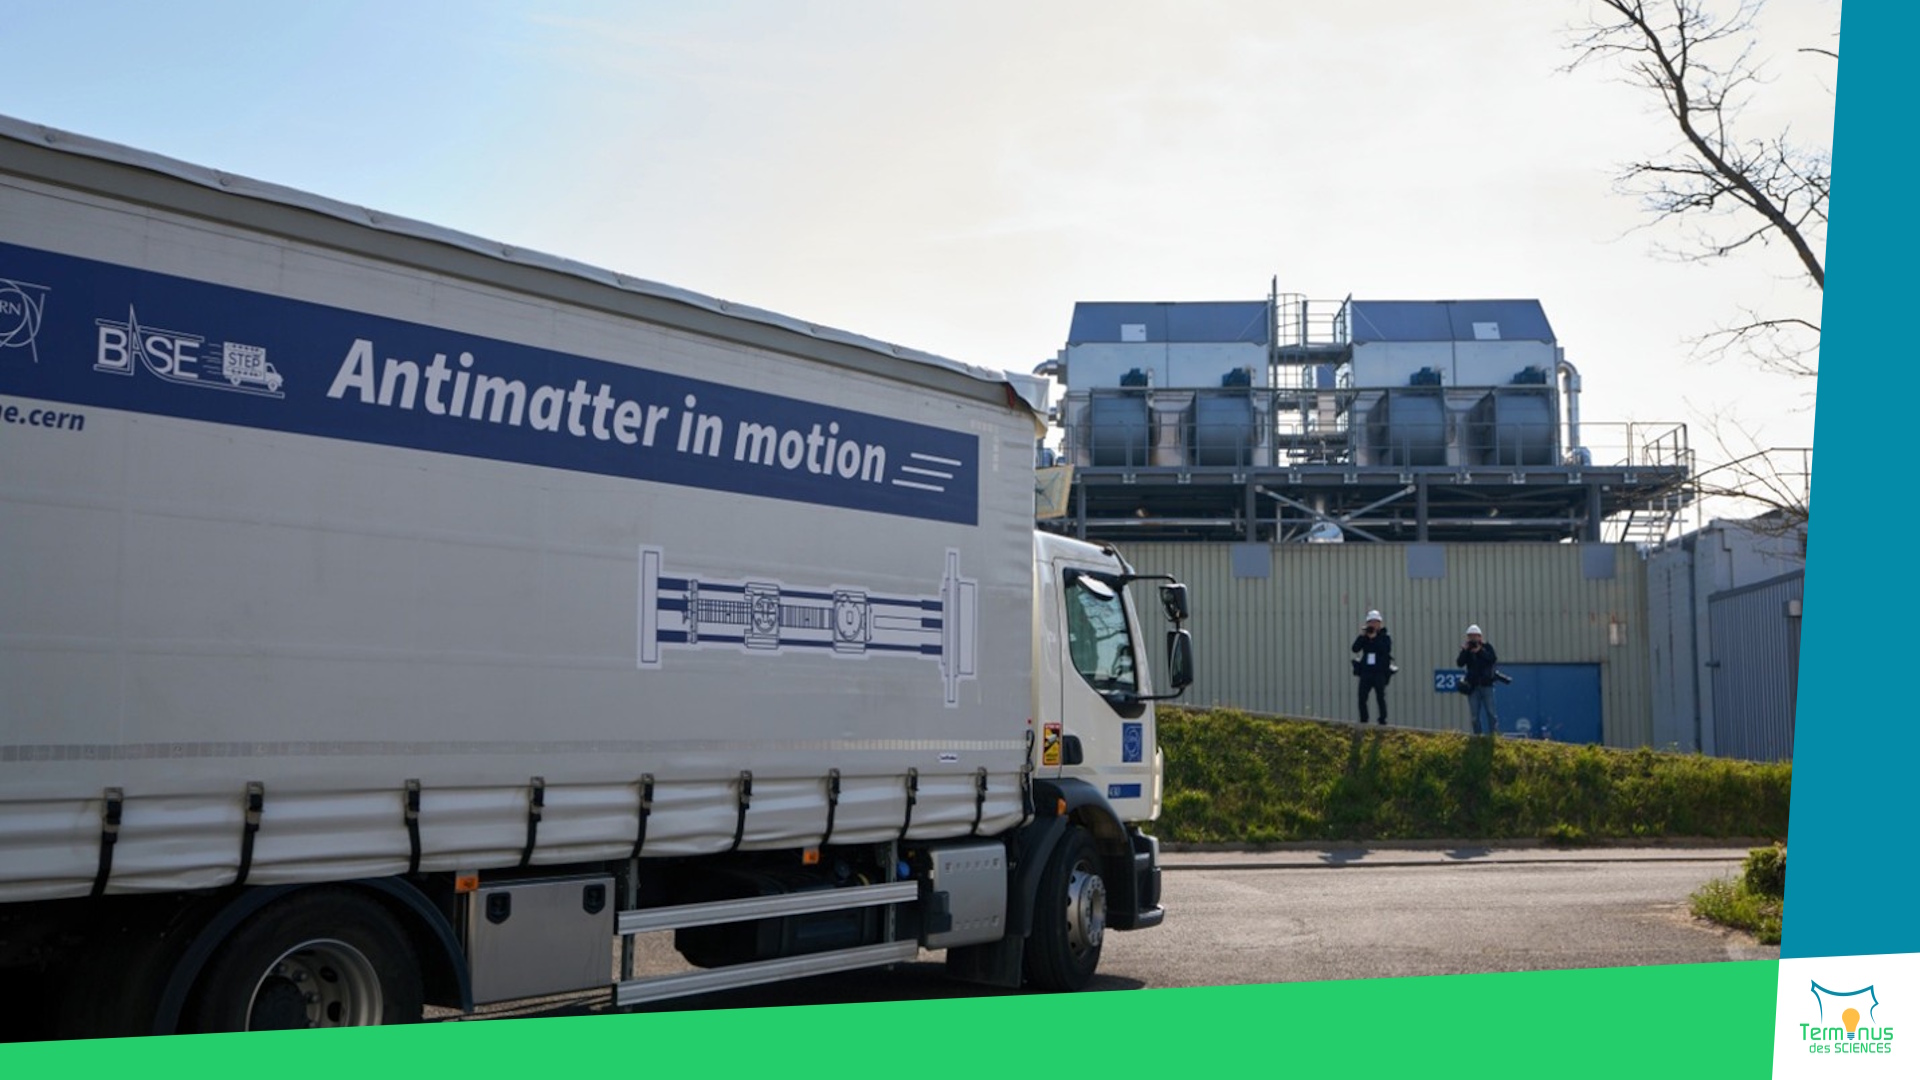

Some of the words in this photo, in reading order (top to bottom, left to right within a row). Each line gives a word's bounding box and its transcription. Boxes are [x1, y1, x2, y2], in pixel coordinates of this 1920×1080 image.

[98, 306, 200, 378] BASE
[228, 352, 261, 370] STEP
[0, 404, 85, 431] e.cern
[326, 338, 670, 448] Antimatter
[677, 394, 723, 457] in
[734, 421, 887, 483] motion
